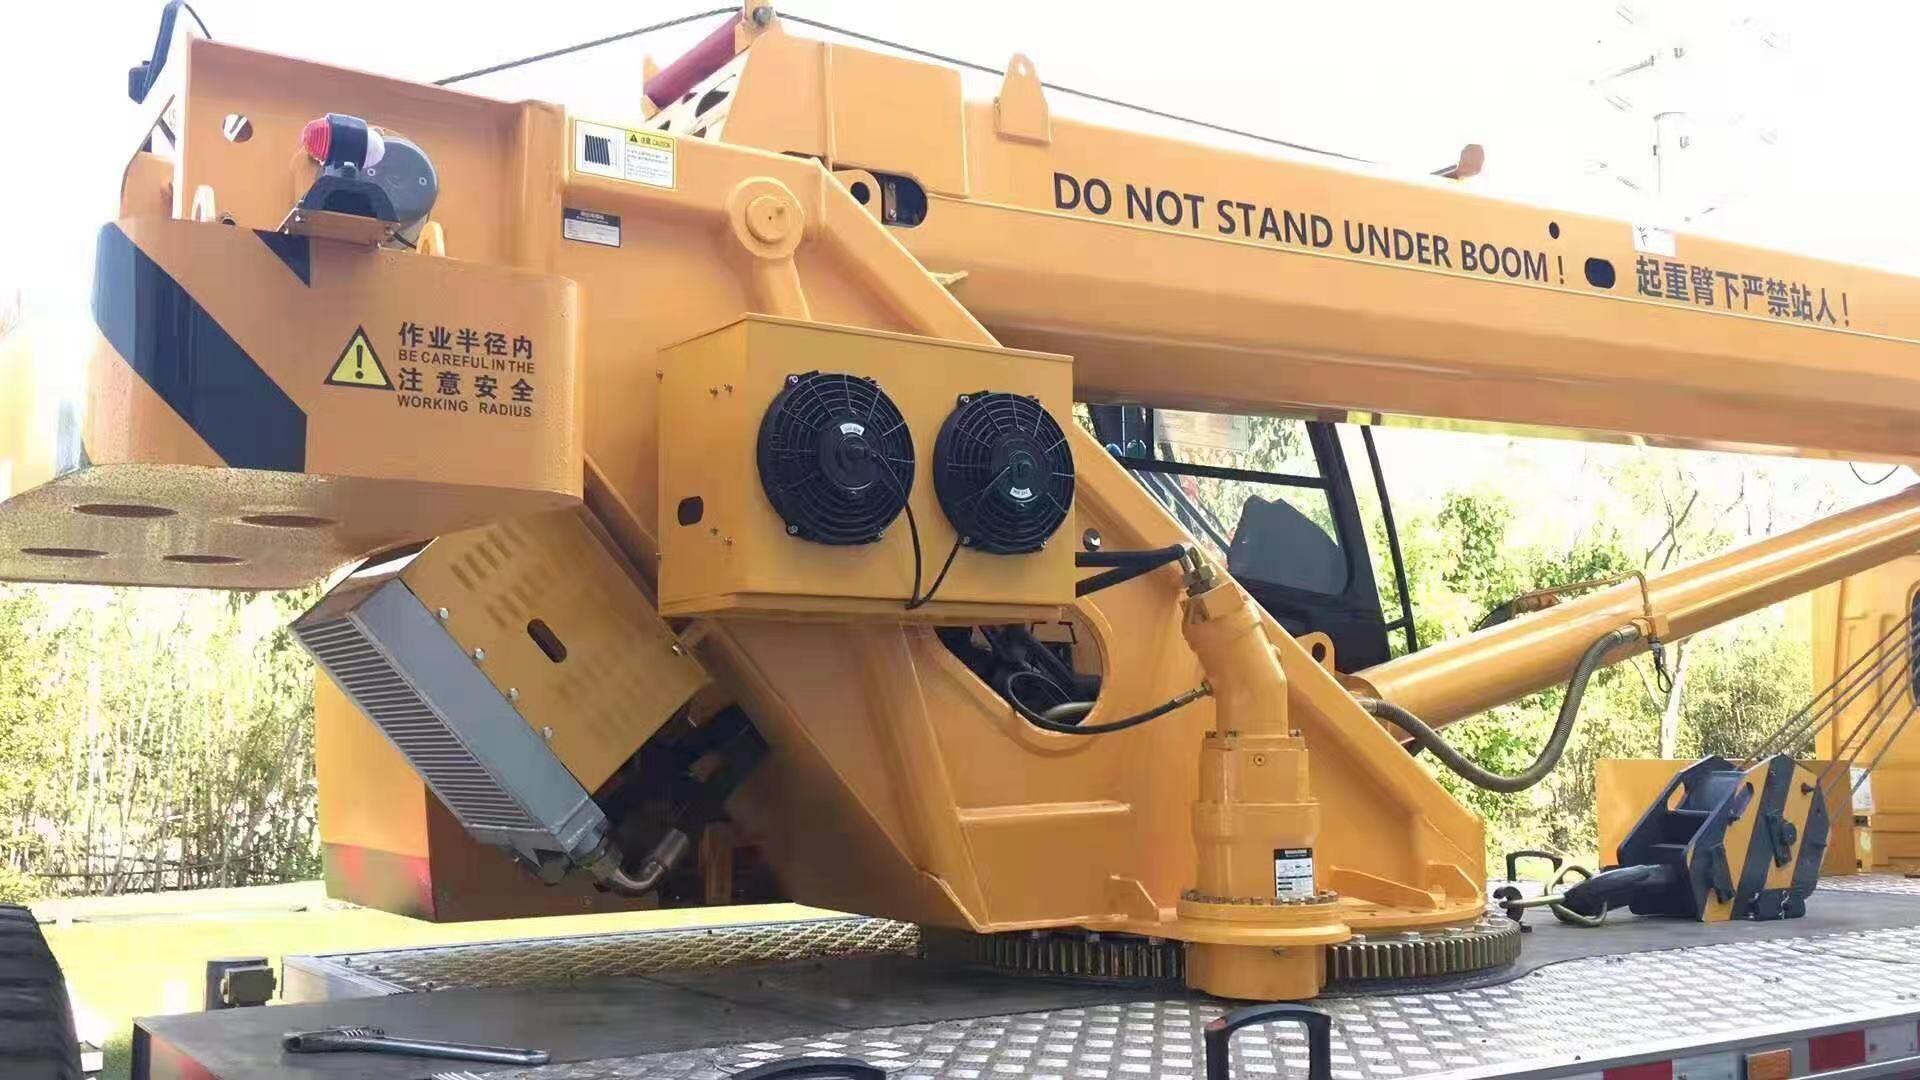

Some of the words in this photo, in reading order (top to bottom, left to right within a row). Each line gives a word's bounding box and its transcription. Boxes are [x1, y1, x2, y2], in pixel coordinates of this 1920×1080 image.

[1054, 172, 1112, 214] DO
[1126, 184, 1205, 229] NOT
[1217, 200, 1332, 248] STAND
[1344, 220, 1452, 268] UNDER
[398, 321, 532, 359] 作业半径内
[399, 350, 417, 362] BE
[422, 351, 488, 369] CAREFUL
[492, 361, 506, 371] IN
[508, 361, 535, 374] THE
[398, 367, 534, 402] 注意安全
[397, 395, 468, 413] WORKING
[479, 402, 532, 417] RADIUS
